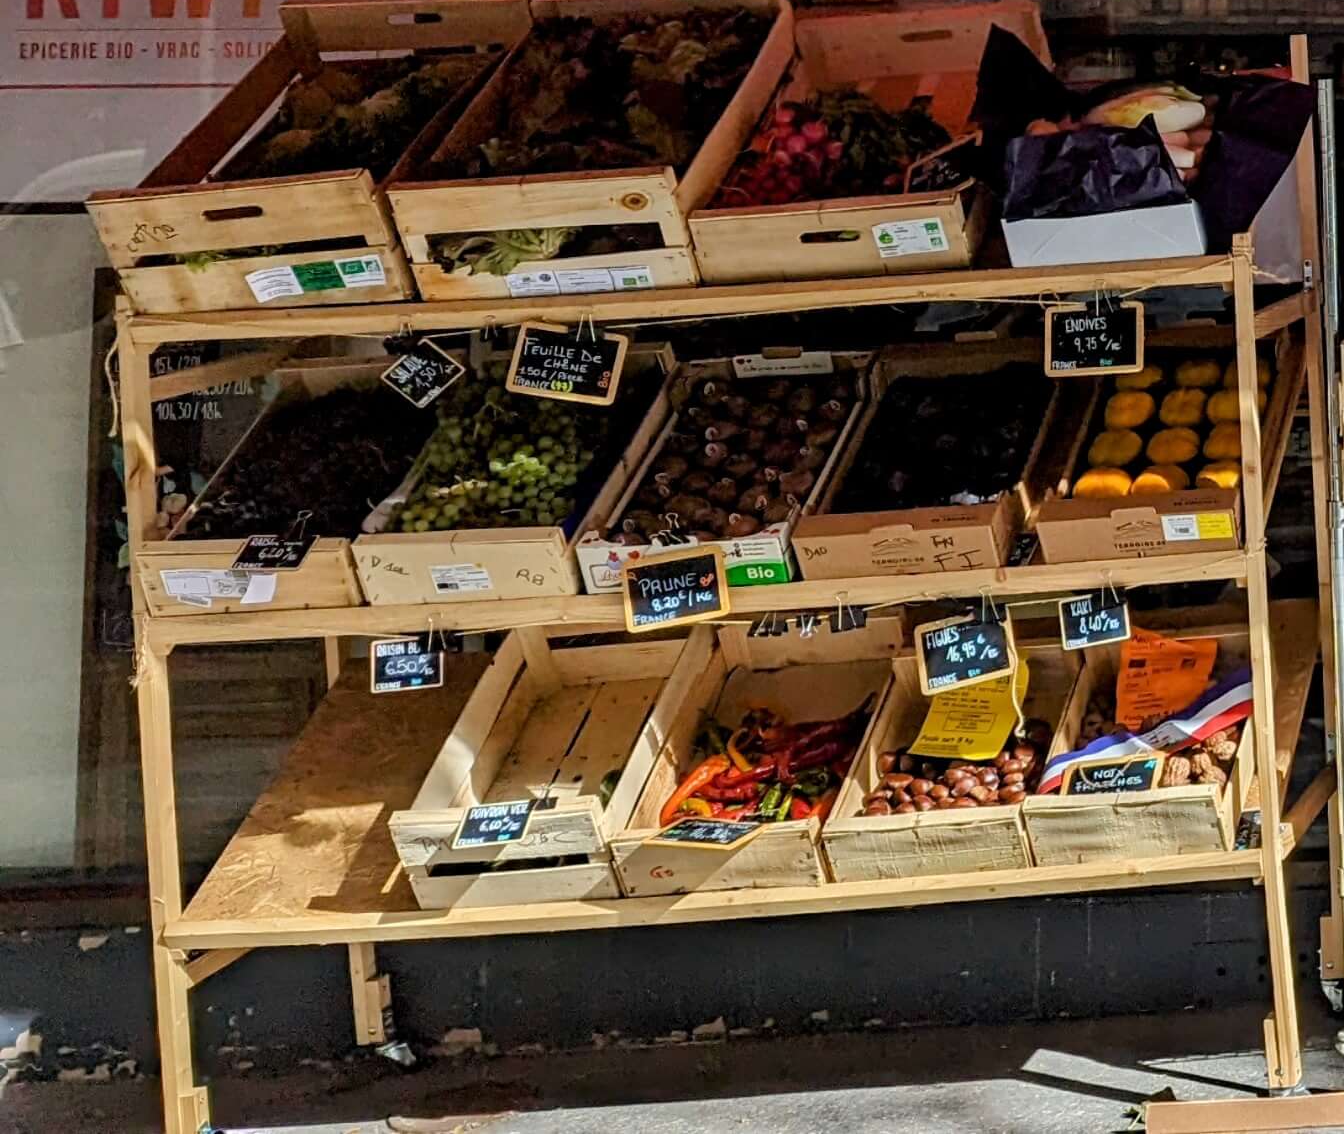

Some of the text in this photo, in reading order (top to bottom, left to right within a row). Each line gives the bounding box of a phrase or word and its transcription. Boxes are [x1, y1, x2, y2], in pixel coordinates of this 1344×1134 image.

[19, 42, 97, 60] EPICERIE
[105, 41, 134, 60] BIO
[156, 40, 200, 59] VRAC
[1065, 316, 1108, 333] ENDIVES
[746, 566, 775, 580] Bio
[638, 573, 697, 598] PRUNE
[1070, 600, 1093, 616] KAKI
[633, 611, 677, 626] FRANCE
